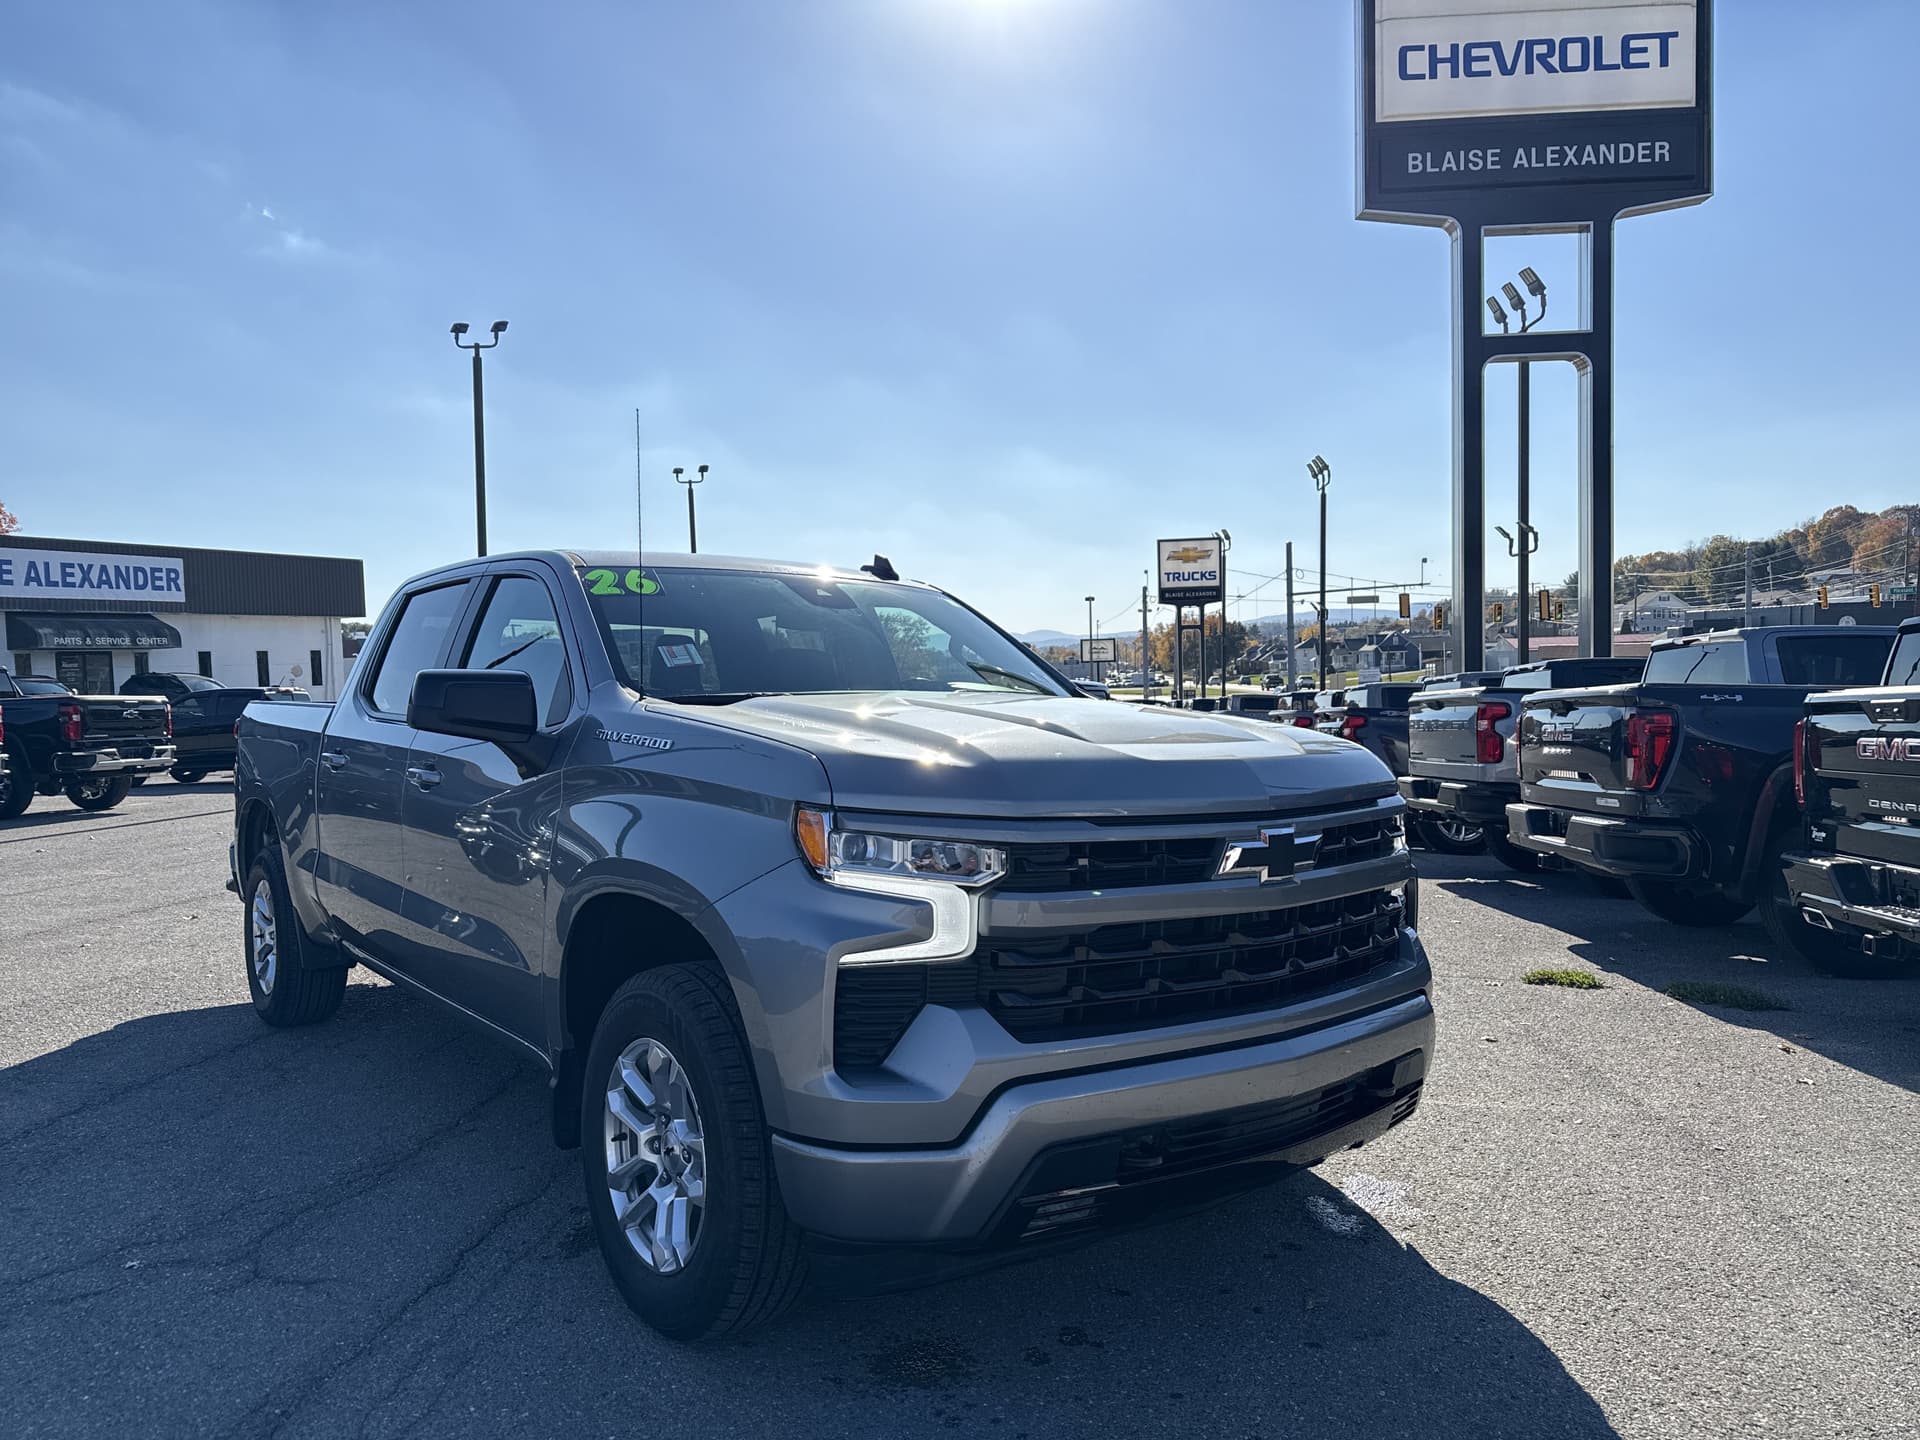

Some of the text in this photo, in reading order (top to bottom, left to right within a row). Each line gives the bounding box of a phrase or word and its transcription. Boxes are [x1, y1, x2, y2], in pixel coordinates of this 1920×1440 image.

[1398, 31, 1679, 81] CHEVROLET
[1407, 141, 1671, 174] BLAISE ALEXANDER
[24, 561, 182, 592] ALEXANDER
[584, 568, 660, 596] 26
[1164, 571, 1217, 582] TRUCKS
[54, 637, 168, 645] PARTS & SERVICE CENTER
[595, 728, 675, 751] SILVERADO
[1856, 737, 1920, 761] GMC
[1868, 799, 1920, 812] DENA
